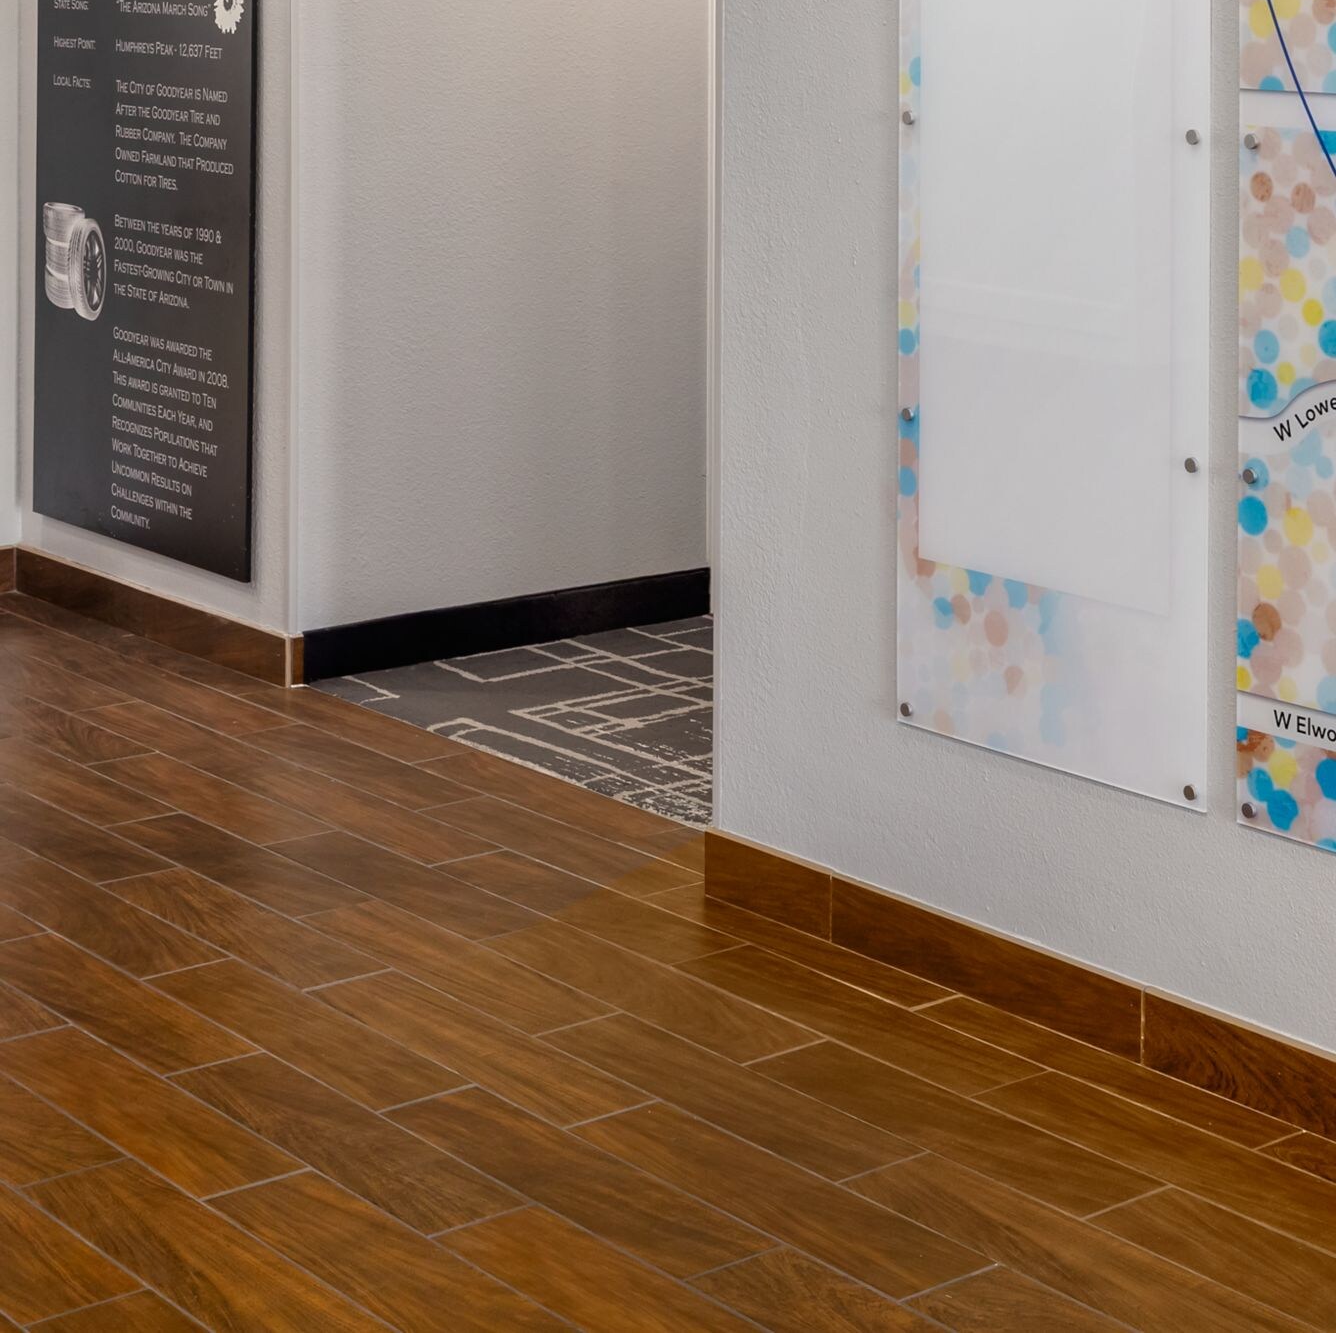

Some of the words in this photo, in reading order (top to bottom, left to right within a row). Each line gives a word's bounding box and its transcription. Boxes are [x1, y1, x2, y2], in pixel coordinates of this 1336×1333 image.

[133, 1, 161, 14] ARIZONA
[54, 36, 76, 48] HIGHEST
[116, 39, 154, 54] HUMPHREYS
[156, 42, 173, 55] PEAK
[179, 44, 203, 58] 12,637
[205, 45, 222, 59] FEET
[53, 74, 71, 87] LOCAL
[116, 79, 128, 93] THE
[129, 81, 145, 94] CITY
[146, 85, 155, 95] OF
[156, 83, 193, 99] GOODYEAR
[195, 89, 201, 100] IS
[203, 88, 228, 103] NAMED
[116, 103, 137, 116] AFTER
[138, 106, 150, 118] THE
[152, 106, 188, 122] GOODYEAR
[190, 110, 204, 124] TIRE
[206, 114, 220, 126] AND
[116, 125, 141, 140] RUBBER
[179, 132, 192, 146] THE
[194, 134, 227, 150] COMPANY
[115, 147, 140, 162] OWNED
[142, 150, 177, 167] FARMLAND
[178, 156, 195, 169] THAT
[196, 157, 234, 174] PRODUCED
[115, 170, 142, 185] COTTON
[144, 175, 157, 187] FOR
[115, 214, 145, 231] BETWEEN
[147, 221, 159, 234] THE
[161, 224, 182, 238] YEARS
[183, 227, 193, 239] OF
[196, 228, 214, 243] 1990
[215, 231, 221, 244] &
[136, 241, 172, 259] GOODYEAR
[174, 250, 188, 263] WAS
[190, 252, 203, 265] THE
[114, 259, 174, 283] FASTEST-GROWING
[176, 271, 192, 286] CITY
[193, 276, 202, 288] OR
[204, 276, 225, 292] TOWN
[226, 282, 233, 294] IN
[114, 283, 126, 296] THE
[127, 284, 147, 300] STATE
[148, 290, 158, 301] OF
[113, 326, 149, 346] GOODYEAR
[150, 336, 164, 350] WAS
[166, 340, 198, 357] AWARDED
[199, 347, 212, 361] THE
[113, 349, 155, 371] ALL-AMERICA
[156, 358, 172, 375] CITY
[173, 363, 197, 381] AWARD
[198, 370, 205, 383] IN
[113, 371, 127, 386] THIS
[128, 378, 150, 392] AWARD
[152, 383, 158, 394] IS
[159, 385, 190, 402] GRANTED
[191, 392, 201, 405] TO
[202, 393, 217, 409] TEN
[113, 394, 156, 416] COMMUNITIES
[158, 406, 176, 422] EACH
[198, 418, 213, 432] AND
[112, 416, 152, 438] RECOGNIZES
[154, 427, 199, 451] POPULATIONS
[201, 441, 218, 457] THAT
[1273, 420, 1291, 441] W
[112, 438, 132, 456] WORK
[133, 444, 166, 466] TOGETHER
[168, 455, 177, 468] TO
[178, 458, 207, 478] ACHIEVE
[112, 460, 149, 484] UNCOMMON
[151, 472, 180, 493] RESULTS
[181, 483, 192, 497] ON
[111, 483, 154, 508] CHALLENGES
[155, 497, 178, 515] WITHIN
[179, 506, 192, 520] THE
[1274, 710, 1291, 730] W
[1297, 716, 1336, 742] Elwo
